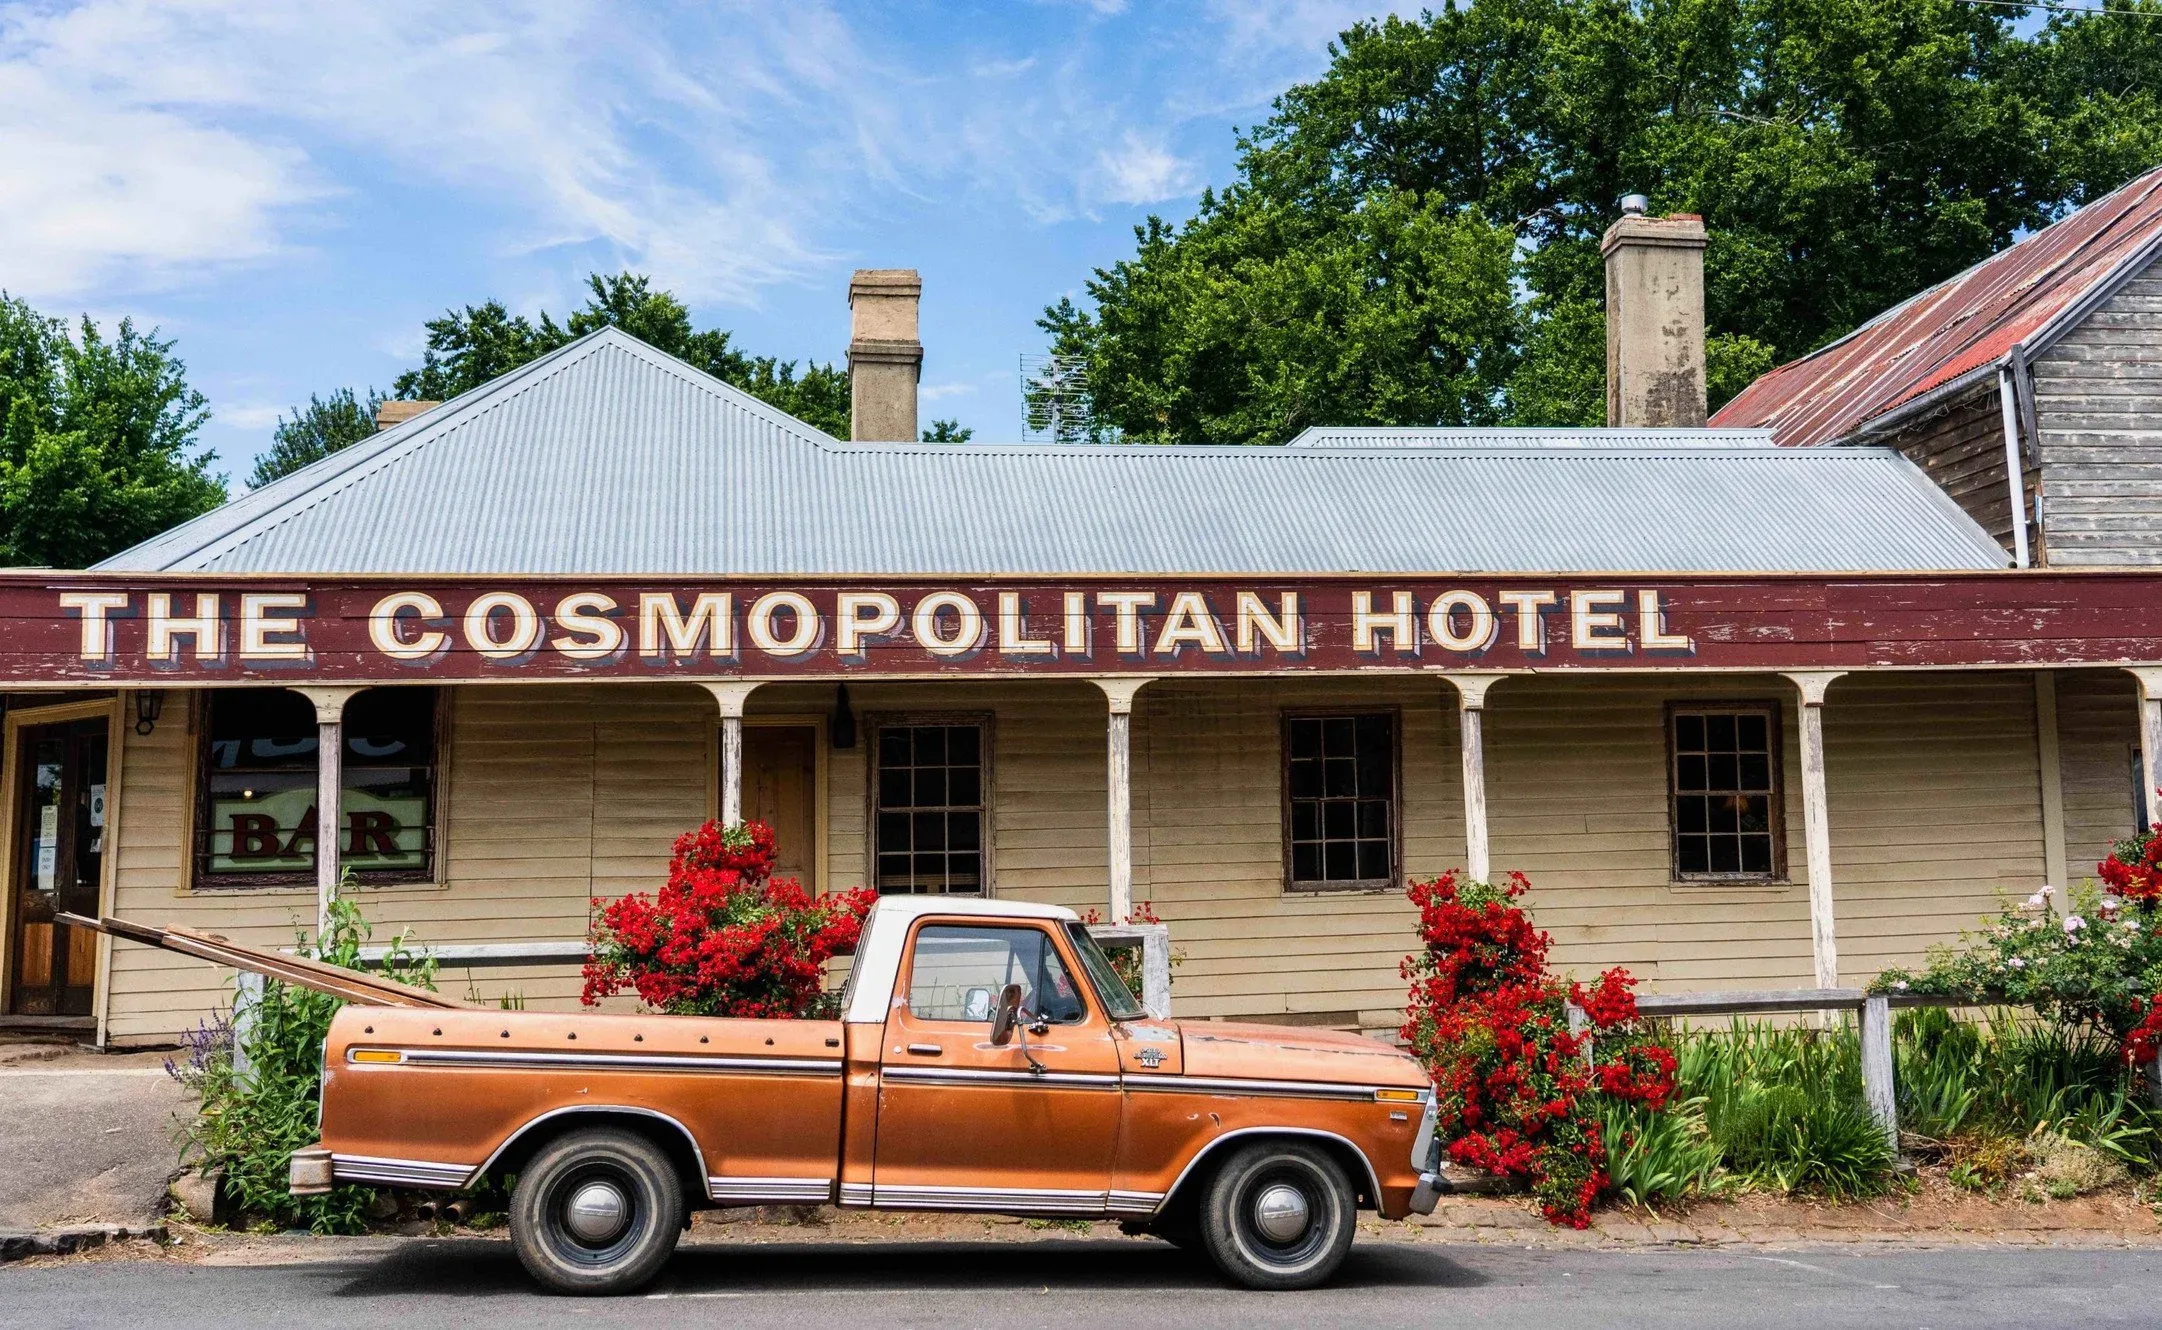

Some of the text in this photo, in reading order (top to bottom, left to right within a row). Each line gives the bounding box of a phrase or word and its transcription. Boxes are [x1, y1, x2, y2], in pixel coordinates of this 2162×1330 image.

[59, 589, 1690, 661] THE COSMOPOLITAN HOTEL
[229, 804, 401, 859] BAR
[1140, 1057, 1160, 1067] XLT
